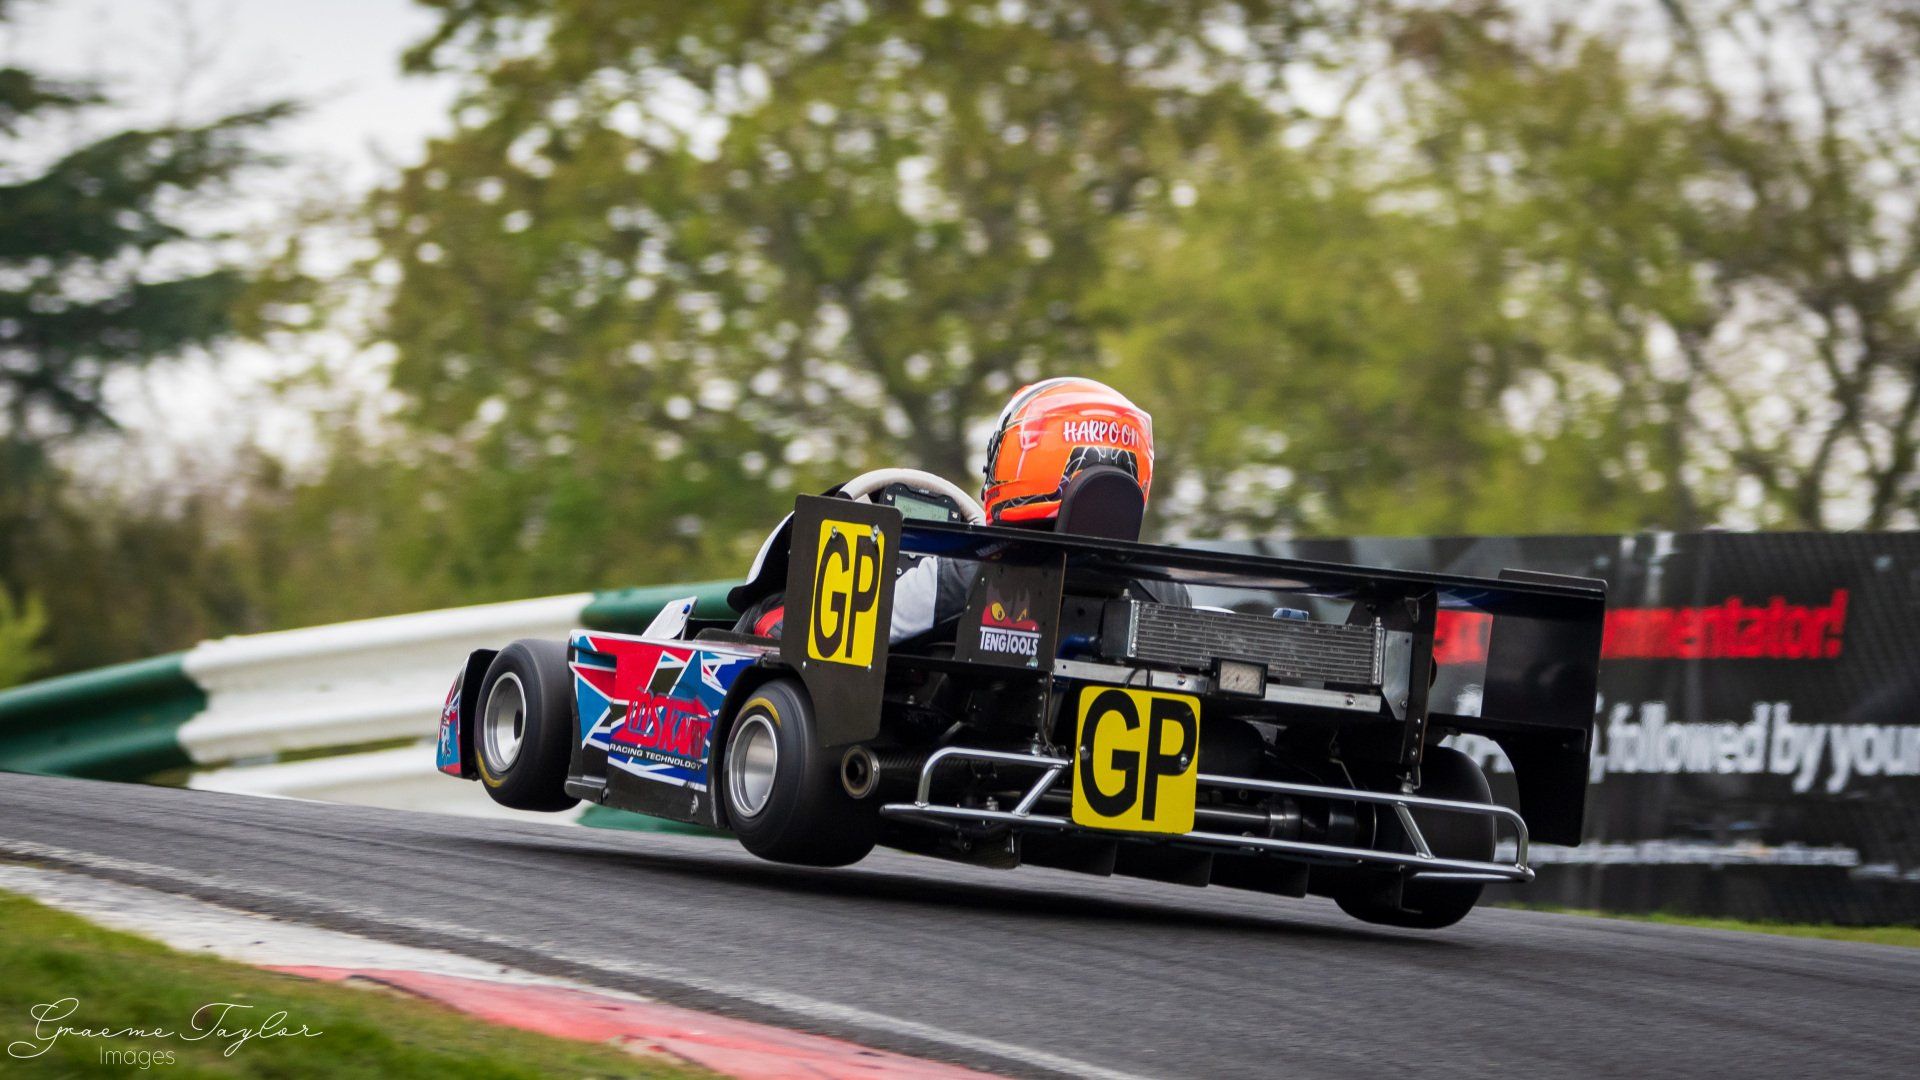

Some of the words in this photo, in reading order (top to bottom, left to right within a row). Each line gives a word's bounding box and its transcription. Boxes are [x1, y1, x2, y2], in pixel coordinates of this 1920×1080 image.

[813, 531, 880, 659] GP
[1602, 588, 1848, 659] mmentator!
[609, 743, 643, 757] RACING
[646, 751, 702, 770] TECHNOLOGY
[1080, 689, 1197, 822] GP
[1769, 701, 1828, 793] by
